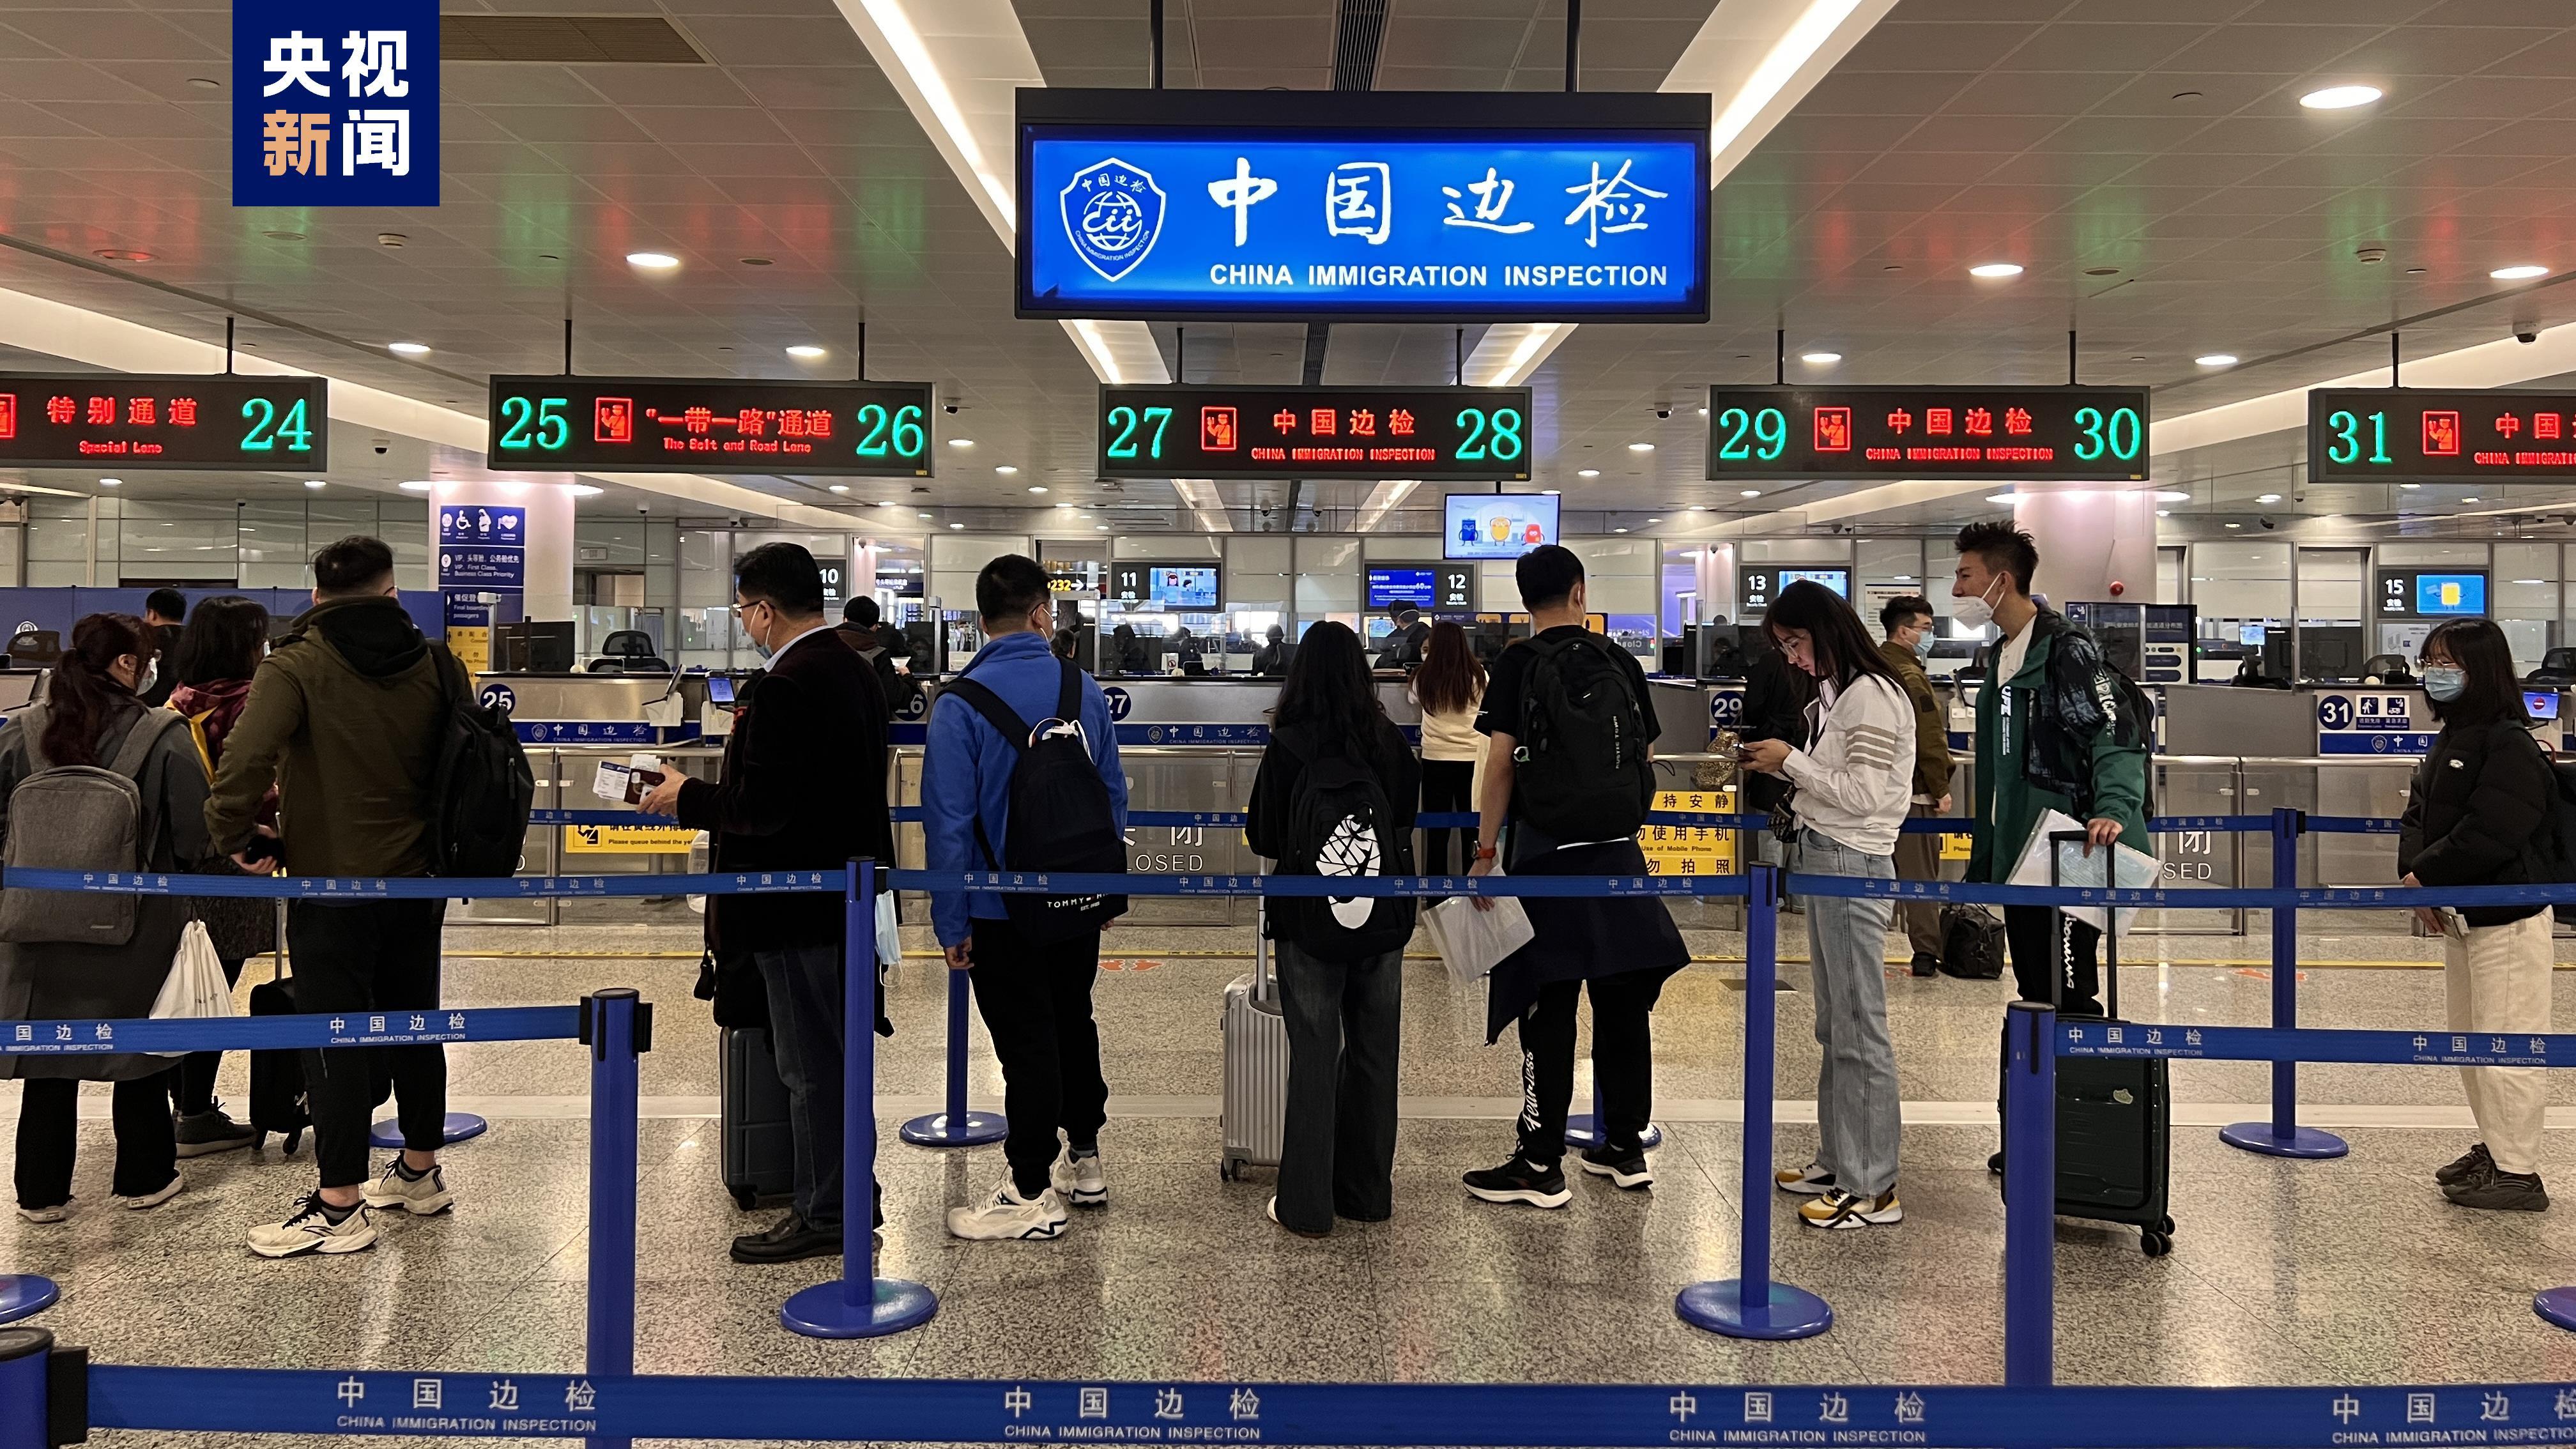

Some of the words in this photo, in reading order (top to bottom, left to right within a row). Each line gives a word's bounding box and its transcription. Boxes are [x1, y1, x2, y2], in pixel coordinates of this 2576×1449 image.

[1082, 173, 1146, 193] 中国边检
[1208, 157, 1669, 247] 中国边检
[1210, 265, 1293, 286] CHINA
[1308, 265, 1487, 286] IMMIGRATION
[1505, 265, 1667, 286] INSPECTION
[47, 396, 197, 425] 特别通道
[241, 398, 312, 450] 24
[499, 397, 568, 449] 25
[856, 404, 924, 456] 26
[1273, 409, 1414, 436] 中国边检
[1887, 408, 2033, 436] 中国边检
[2496, 412, 2576, 440] 中国
[1107, 408, 1172, 459] 27
[1455, 408, 1522, 460] 28
[1719, 408, 1786, 460] 29
[2074, 408, 2141, 461] 30
[2328, 411, 2393, 463] 31
[79, 441, 127, 454] Special
[133, 441, 163, 454] Lane
[663, 437, 684, 450] The
[689, 438, 717, 451] Belt
[723, 440, 744, 451] and
[749, 439, 778, 452] Road
[783, 440, 811, 454] Lane
[1251, 447, 1285, 460] CHINA
[1292, 448, 1363, 461] IMMIGRATION
[1370, 448, 1436, 461] INSPECTION
[1866, 448, 1901, 461] CHINA
[1906, 448, 1981, 461] IMMIGRATION
[1986, 448, 2053, 461] INSPECTION
[2474, 452, 2510, 464] CHINA
[820, 569, 839, 584] 10
[1121, 572, 1137, 586] 11
[1448, 574, 1466, 589] 12
[1748, 575, 1767, 590] 13
[2385, 579, 2404, 594] 15
[484, 692, 512, 709] 25
[895, 694, 924, 714] 6
[1714, 698, 1742, 717] 29
[2323, 702, 2349, 723] 31
[553, 723, 647, 736] 中国边检
[1169, 726, 1261, 738] 中国边检
[1663, 793, 1729, 809] 持安静
[1127, 854, 1203, 871] OSED
[1647, 858, 1729, 873] 勿拍照
[737, 872, 822, 885] 中国边检
[964, 873, 1048, 885] 中国边检
[1179, 876, 1262, 887] 中国边检
[1394, 878, 1478, 889] 中国边检
[1609, 877, 1692, 889] 中国边检
[1046, 897, 1084, 908] TOMMY
[15, 1023, 113, 1041] 国边检
[330, 1013, 465, 1034] 中国边检
[359, 1035, 413, 1043] IMMIGRATION
[417, 1033, 466, 1041] INSPECTION
[2069, 1026, 2202, 1045] 中国边检
[2413, 1034, 2546, 1054] 中国边检
[337, 1376, 597, 1412] 中国边检
[1004, 1385, 1260, 1420] 中国边检
[1669, 1390, 1924, 1423] 中国边检
[2332, 1388, 2576, 1424] 中国边检
[337, 1415, 385, 1428] CHINA
[392, 1417, 496, 1431] IMMIGRATION
[503, 1419, 597, 1432] INSPECTION
[1004, 1425, 1051, 1437] CHINA
[1059, 1425, 1161, 1438] IMMIGRATION
[1169, 1427, 1260, 1439] INSPECTION
[1669, 1429, 1716, 1441] CHINA
[1724, 1430, 1825, 1441] IMMIGRATION
[1833, 1430, 1925, 1442] INSPECTION
[2332, 1432, 2379, 1444] CHINA
[2386, 1430, 2487, 1443] IMMIGRATION
[2493, 1427, 2576, 1441] INSPECTIO
